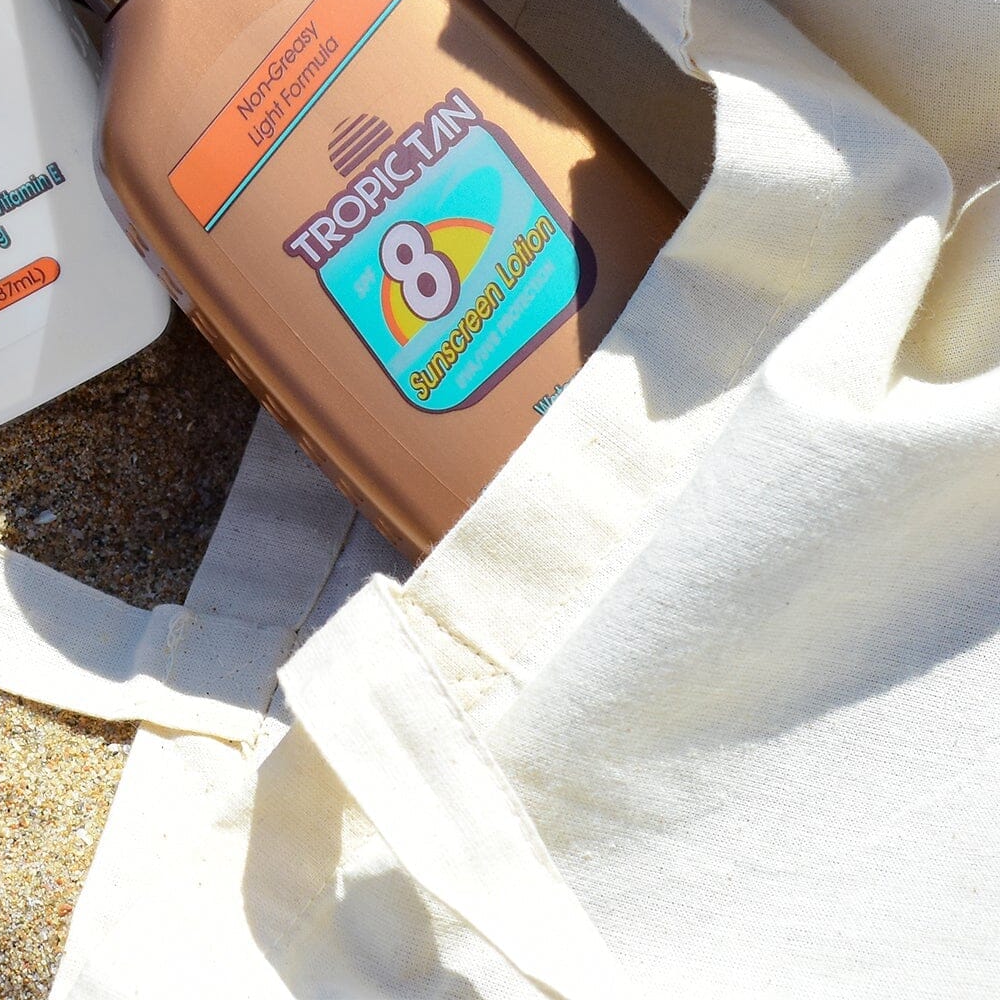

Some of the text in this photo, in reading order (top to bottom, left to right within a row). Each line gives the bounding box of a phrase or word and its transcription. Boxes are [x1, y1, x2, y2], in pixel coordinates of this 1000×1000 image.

[236, 20, 320, 121] Non-Greasy
[247, 35, 340, 148] Light Formula
[46, 161, 67, 186] E
[290, 93, 478, 264] TROPIC TAN
[378, 220, 461, 322] 8
[409, 281, 506, 401] Sunscreen
[494, 215, 557, 291] Lotion
